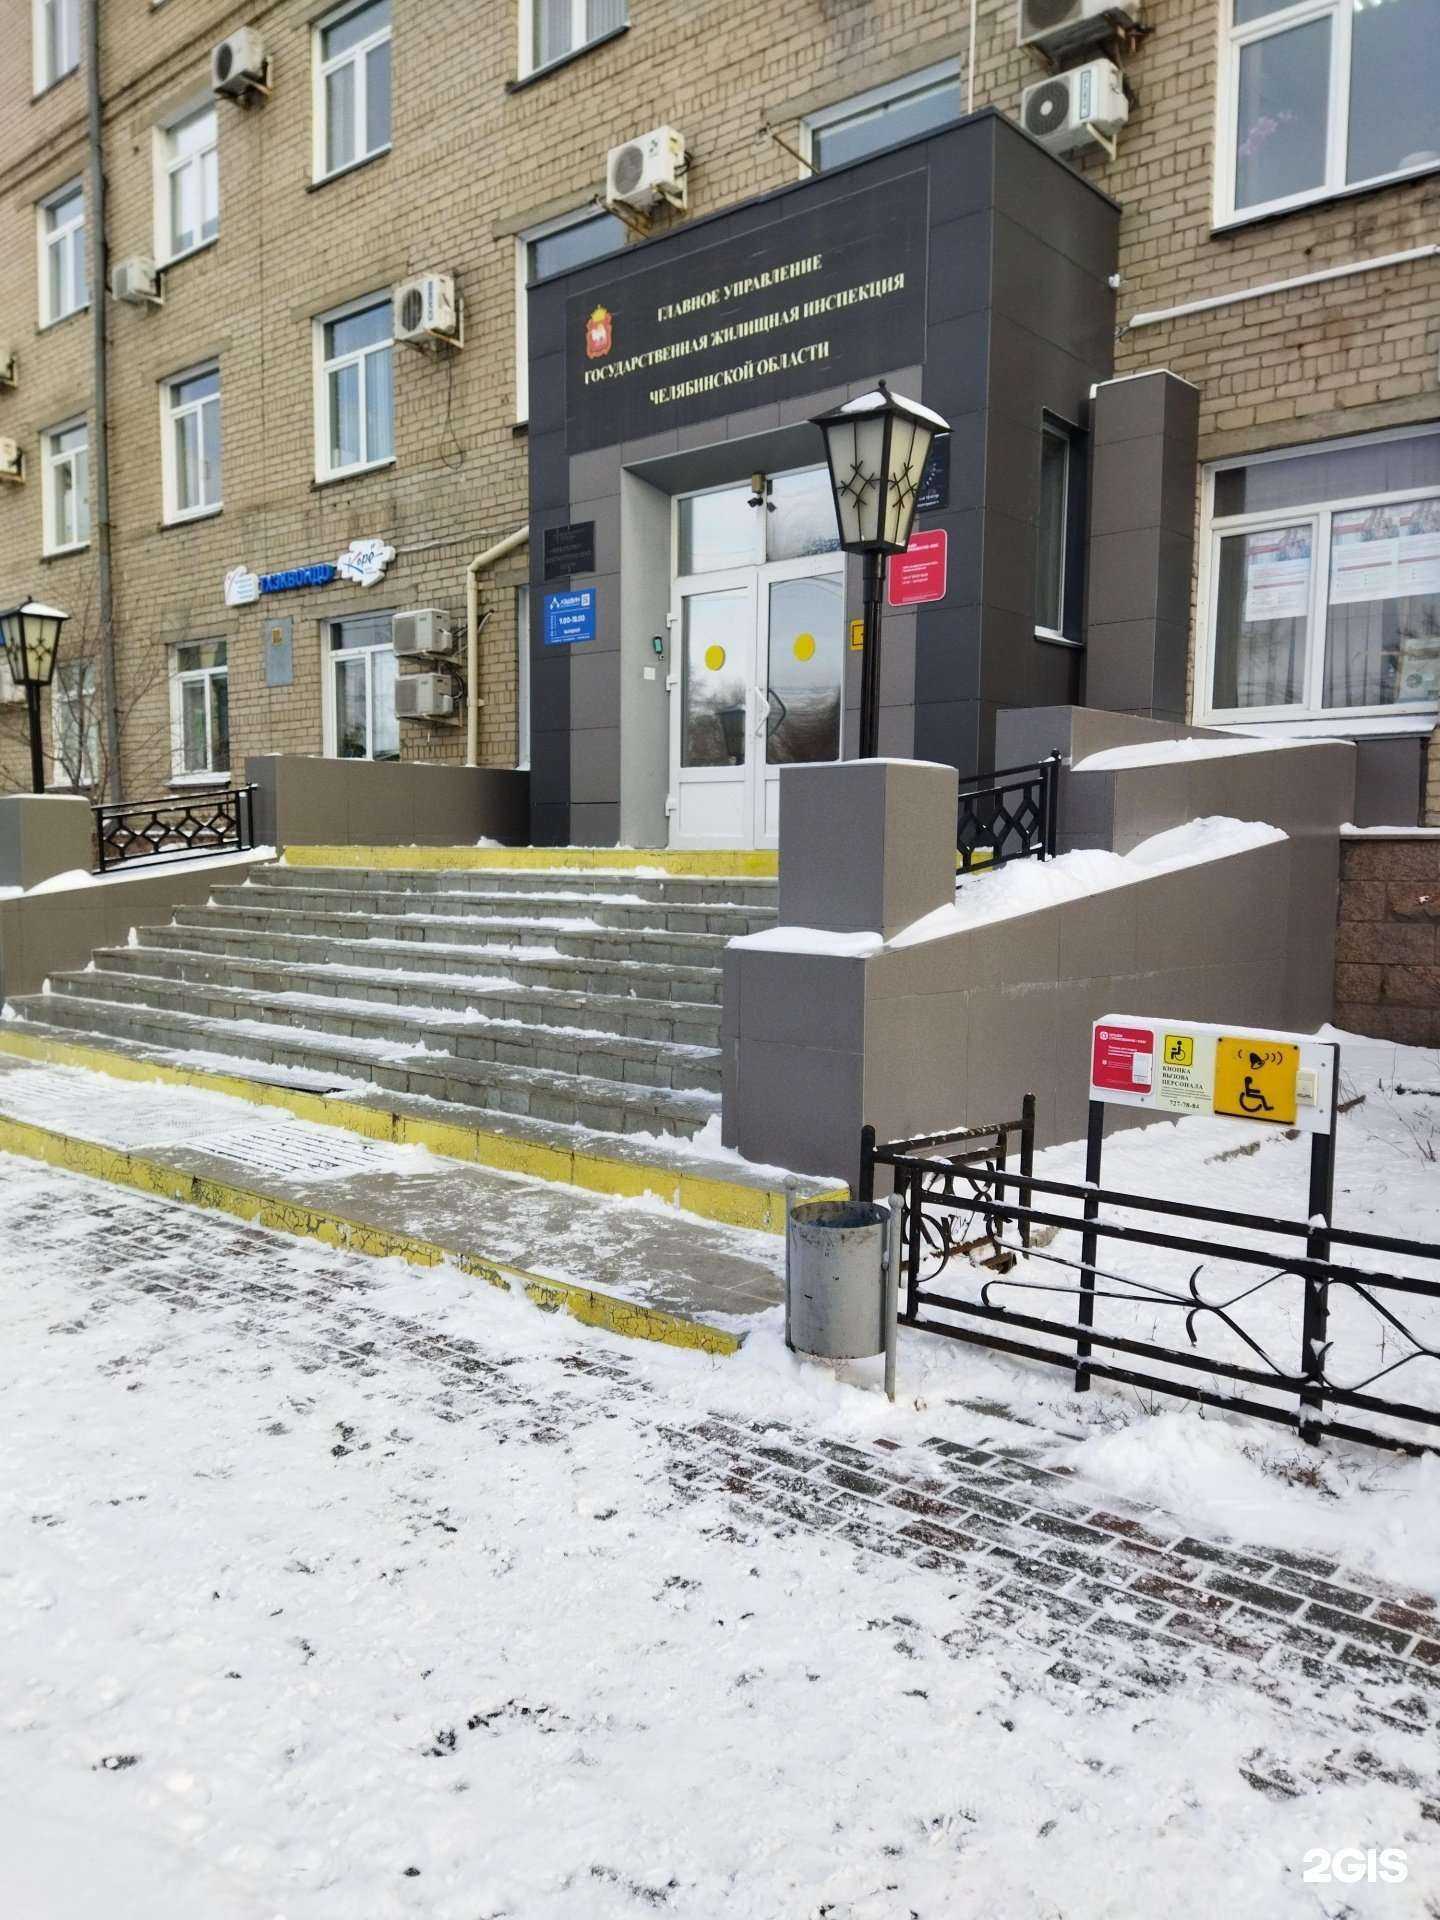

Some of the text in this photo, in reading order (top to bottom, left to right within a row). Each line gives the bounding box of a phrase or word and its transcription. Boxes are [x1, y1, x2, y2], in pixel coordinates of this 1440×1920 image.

[657, 253, 823, 322] ГЛАВНОЕ УПРАВЛЕНИЕ
[584, 273, 906, 385] ГОСУДАРСТВЕННАЯ ЖИЛИЩНАЯ ИНСПЕКЦИЯ
[649, 341, 830, 405] ЧЕЛЯБИНСКОЙ ОБЛАСТИ
[1162, 1065, 1191, 1075] КНОПКА
[1162, 1073, 1189, 1081] ВЫЗОВА
[1162, 1079, 1204, 1090] ПЕРСОНАЛА
